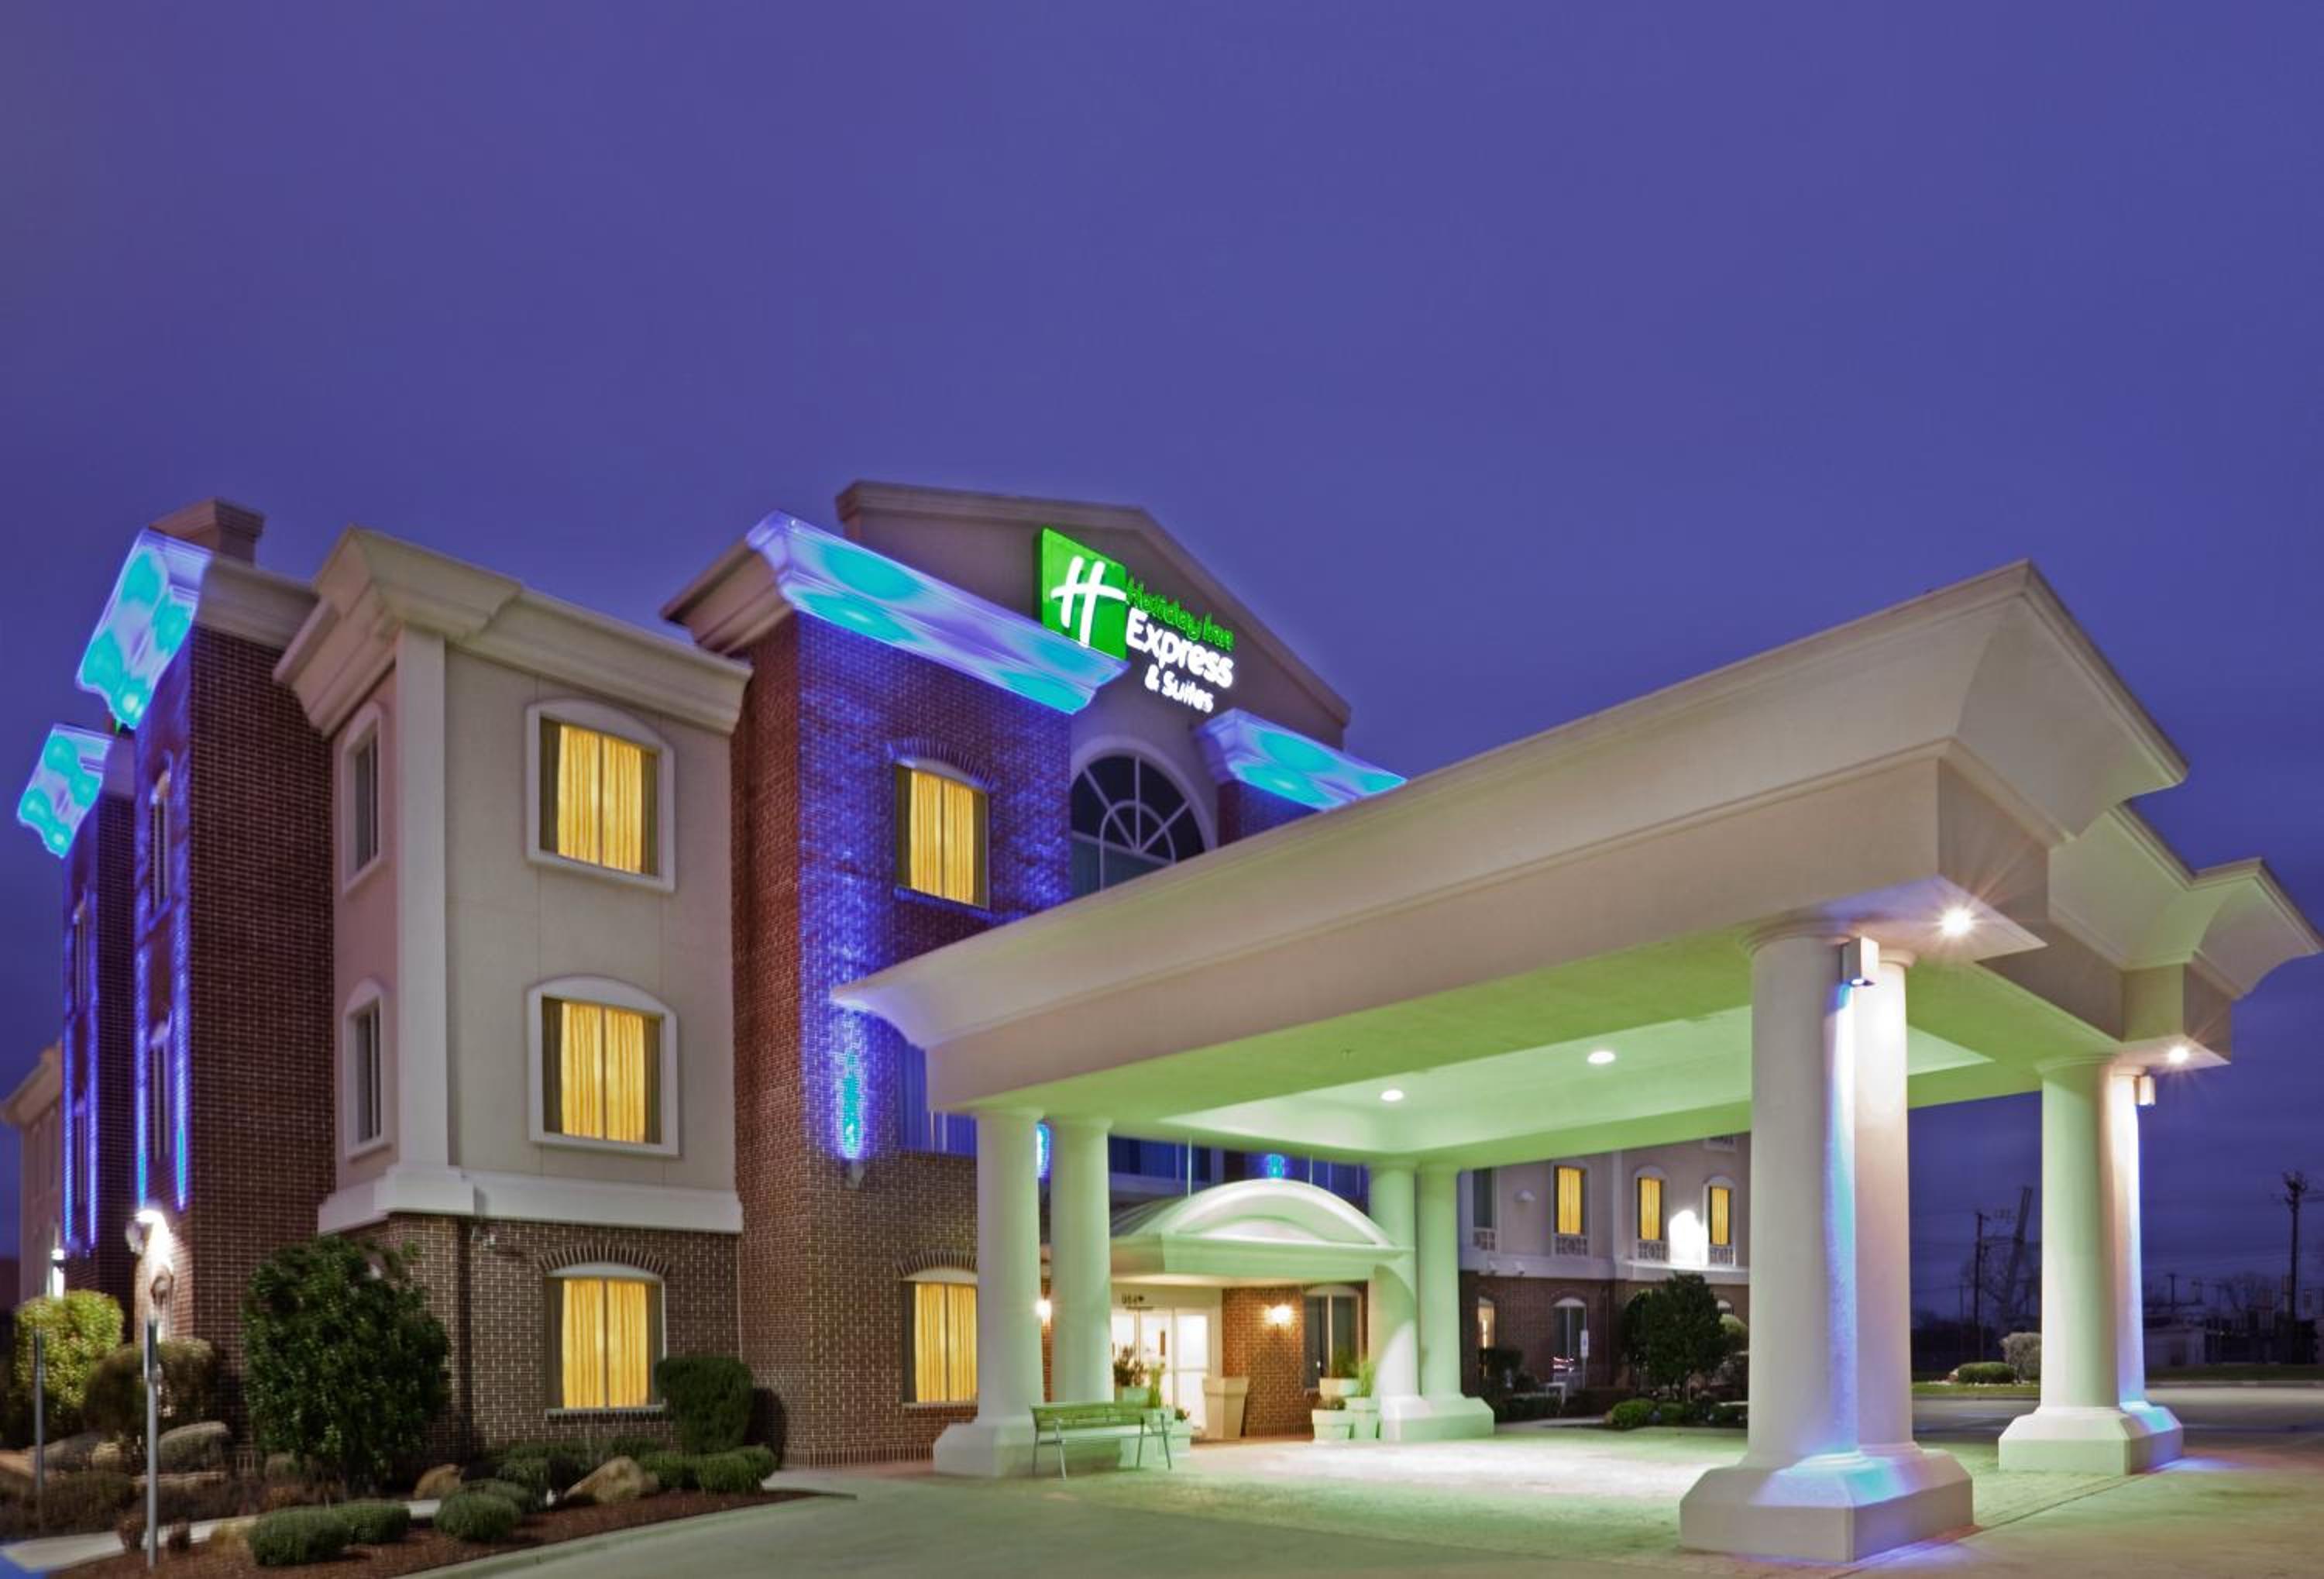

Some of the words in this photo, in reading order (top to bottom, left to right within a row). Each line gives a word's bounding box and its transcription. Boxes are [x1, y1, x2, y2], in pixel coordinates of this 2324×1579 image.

[1126, 607, 1233, 688] Express
[1144, 664, 1161, 692] &
[1162, 671, 1214, 713] Suites
